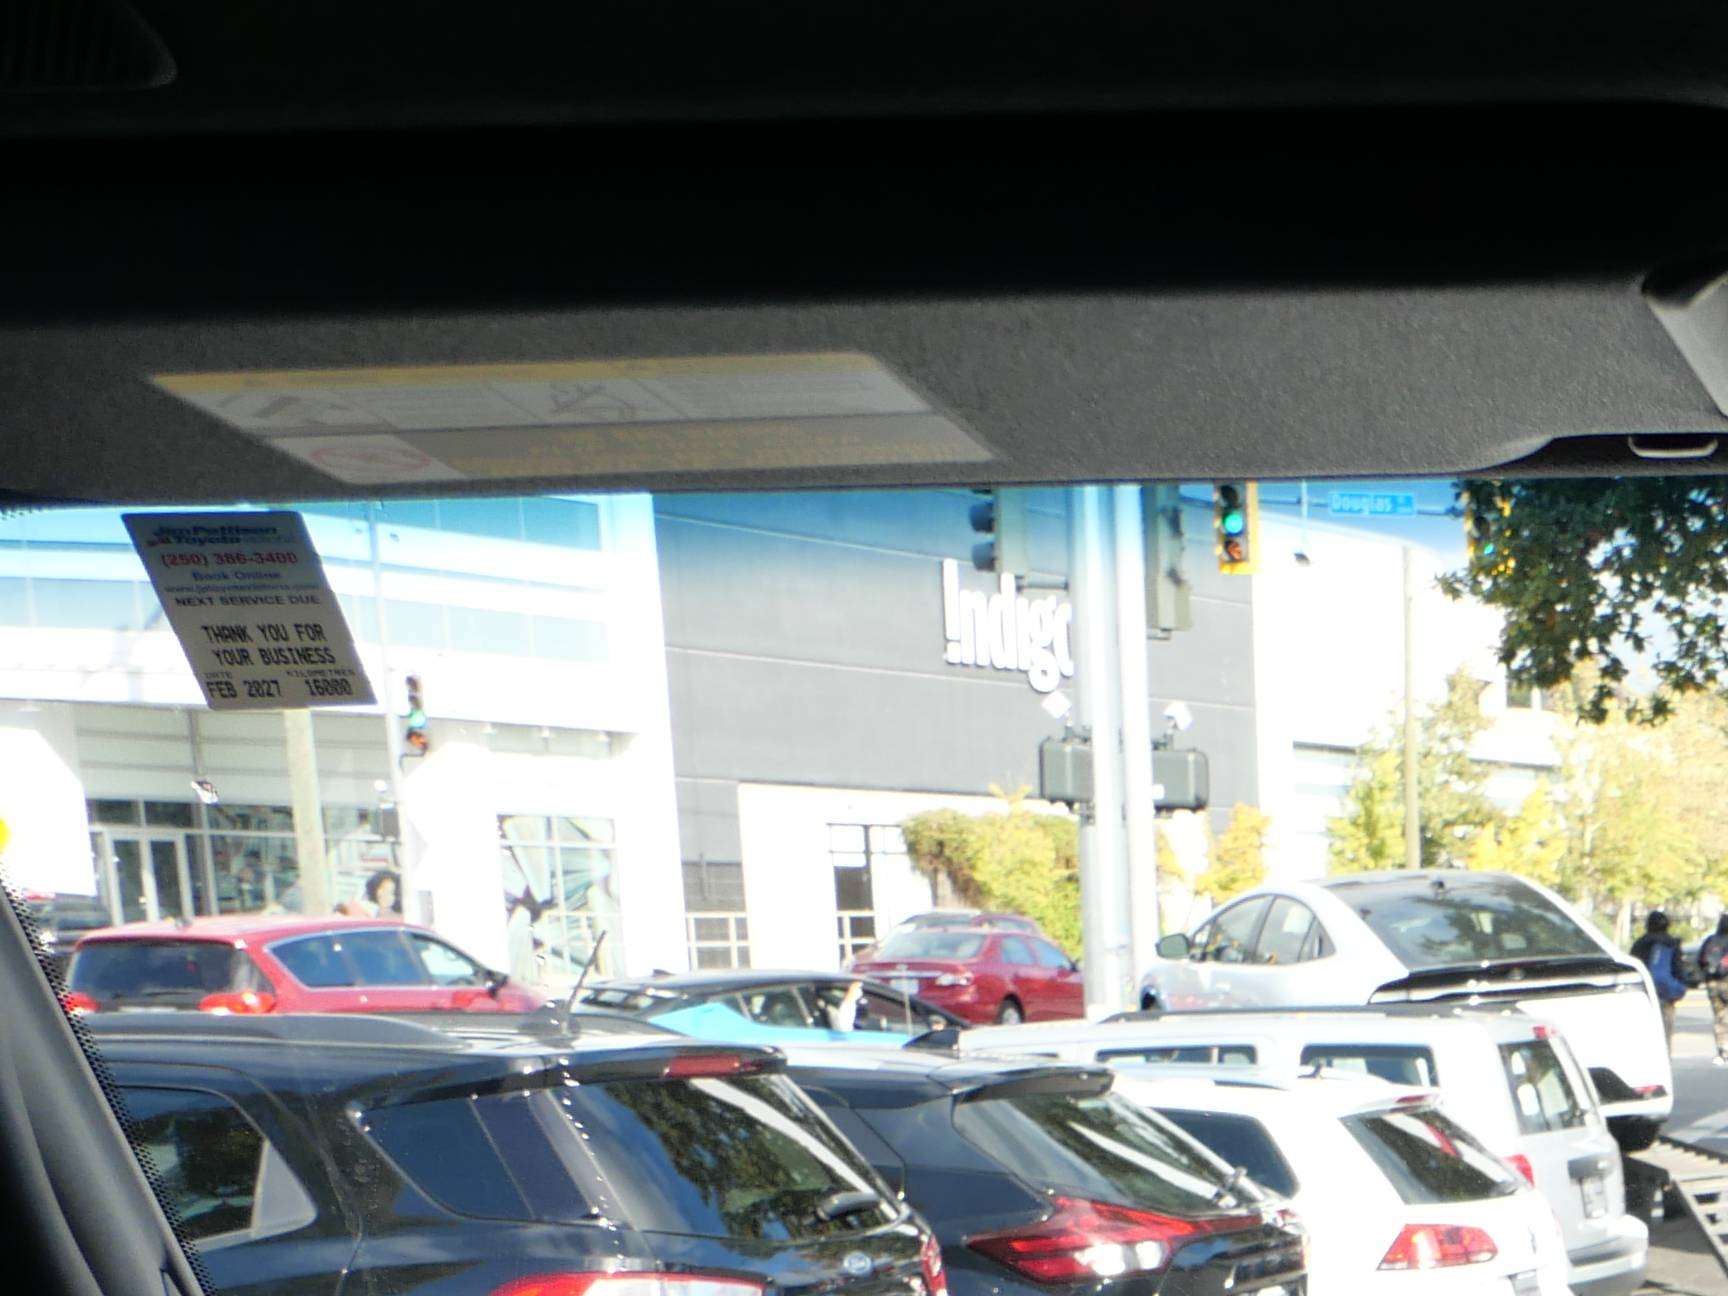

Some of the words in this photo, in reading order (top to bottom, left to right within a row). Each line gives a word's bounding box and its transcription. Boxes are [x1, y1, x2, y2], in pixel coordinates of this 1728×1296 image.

[1331, 494, 1393, 515] Douglas
[175, 596, 215, 607] NEXT
[220, 595, 287, 606] SERVICE
[290, 595, 321, 605] DUE
[201, 624, 253, 644] THANK
[256, 624, 289, 643] YOU
[294, 623, 327, 642] FOR
[213, 648, 255, 667] YOUR
[259, 646, 337, 666] BUSINESS
[206, 682, 238, 700] FEB
